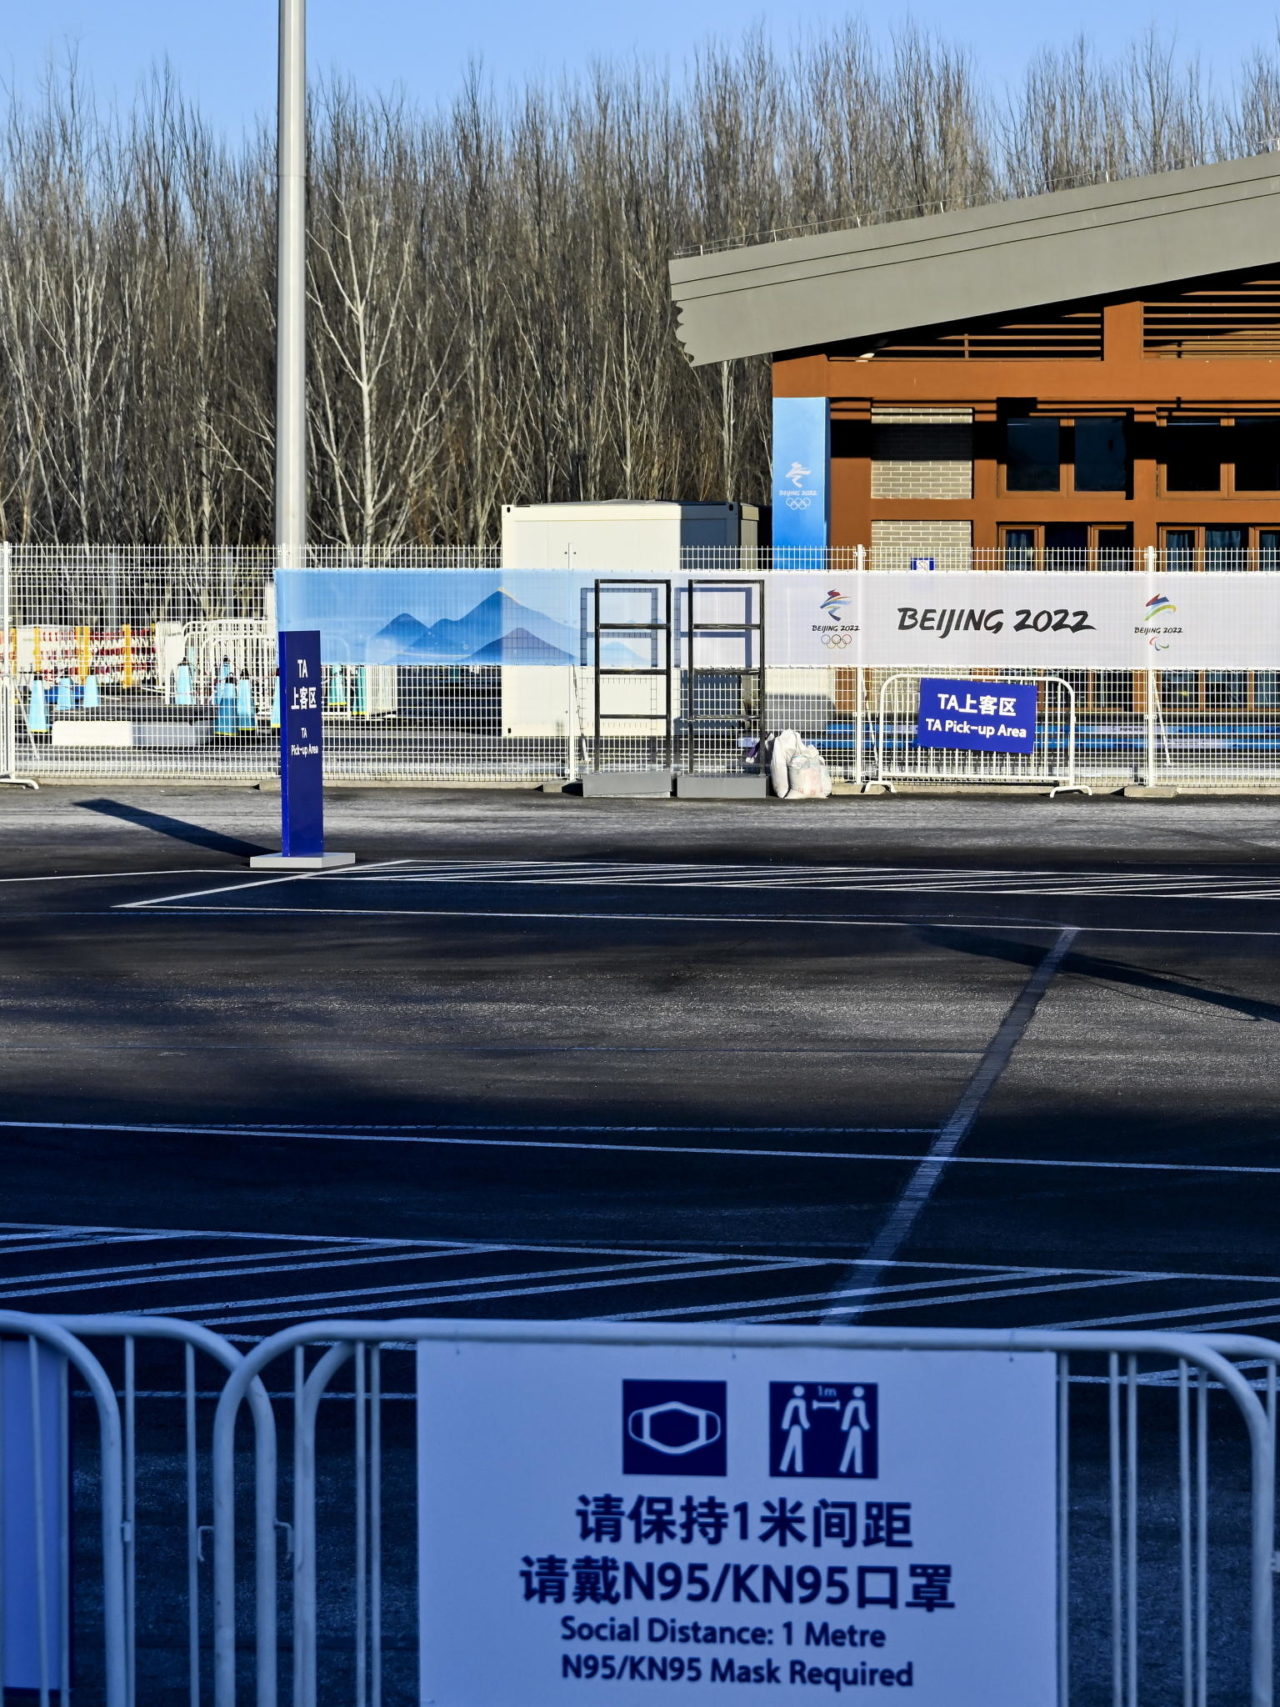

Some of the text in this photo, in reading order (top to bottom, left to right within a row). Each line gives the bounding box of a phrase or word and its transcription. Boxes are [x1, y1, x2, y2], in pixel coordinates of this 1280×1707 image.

[811, 624, 861, 633] BEIJING 2022
[897, 607, 1097, 640] BEIJING 2022
[1134, 626, 1184, 635] BEIJING 2022
[297, 659, 308, 678] TA
[291, 686, 317, 710] 上客区
[937, 693, 1017, 716] TA上客区
[301, 727, 308, 738] TA
[926, 718, 1027, 738] TA Pick-up Area
[291, 743, 319, 758] Pick-up Area
[817, 1384, 837, 1396] 1m
[575, 1494, 914, 1549] 请保持1米间距
[518, 1554, 956, 1613] 请戴N95/KN95口罩
[560, 1616, 886, 1647] Social Distance: 1 Metre
[561, 1654, 914, 1692] N95/KN95 Mask Required
